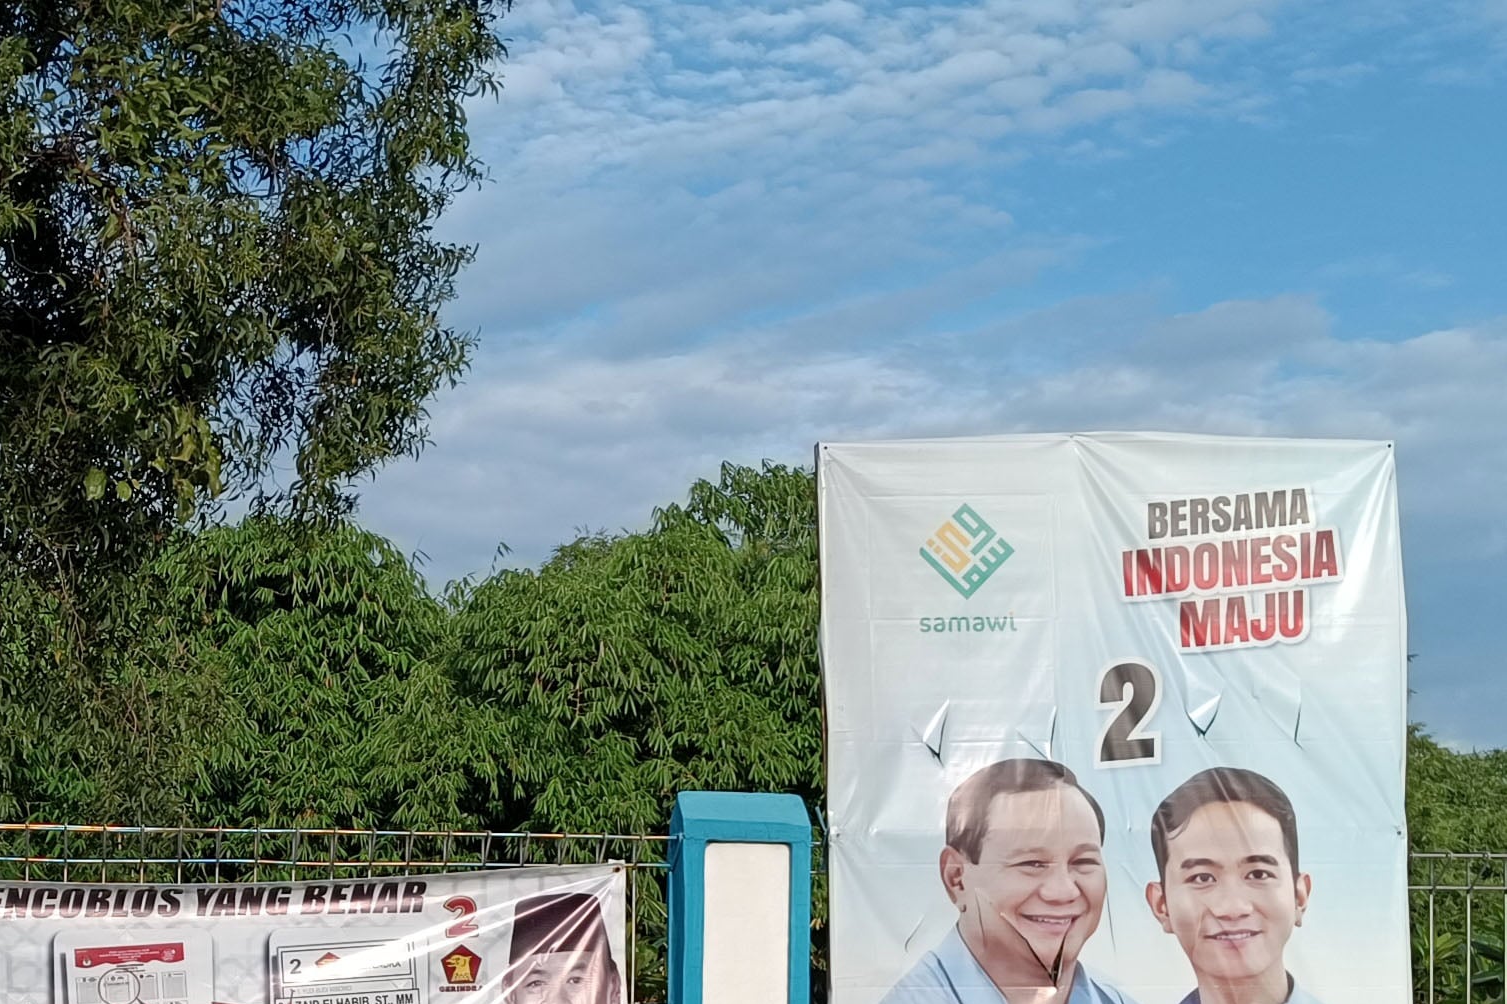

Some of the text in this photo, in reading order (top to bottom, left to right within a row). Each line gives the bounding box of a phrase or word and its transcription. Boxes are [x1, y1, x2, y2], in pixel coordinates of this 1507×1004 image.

[1147, 488, 1310, 540] BERSAMA
[1122, 530, 1338, 597] INDONESIA
[919, 611, 1018, 633] samawi
[1179, 590, 1304, 647] MAJU
[1100, 662, 1155, 762] 2
[194, 886, 292, 916] YANG
[300, 881, 427, 914] BENAR
[443, 895, 478, 938] 2
[289, 958, 302, 975] 2
[396, 994, 414, 1004] MM
